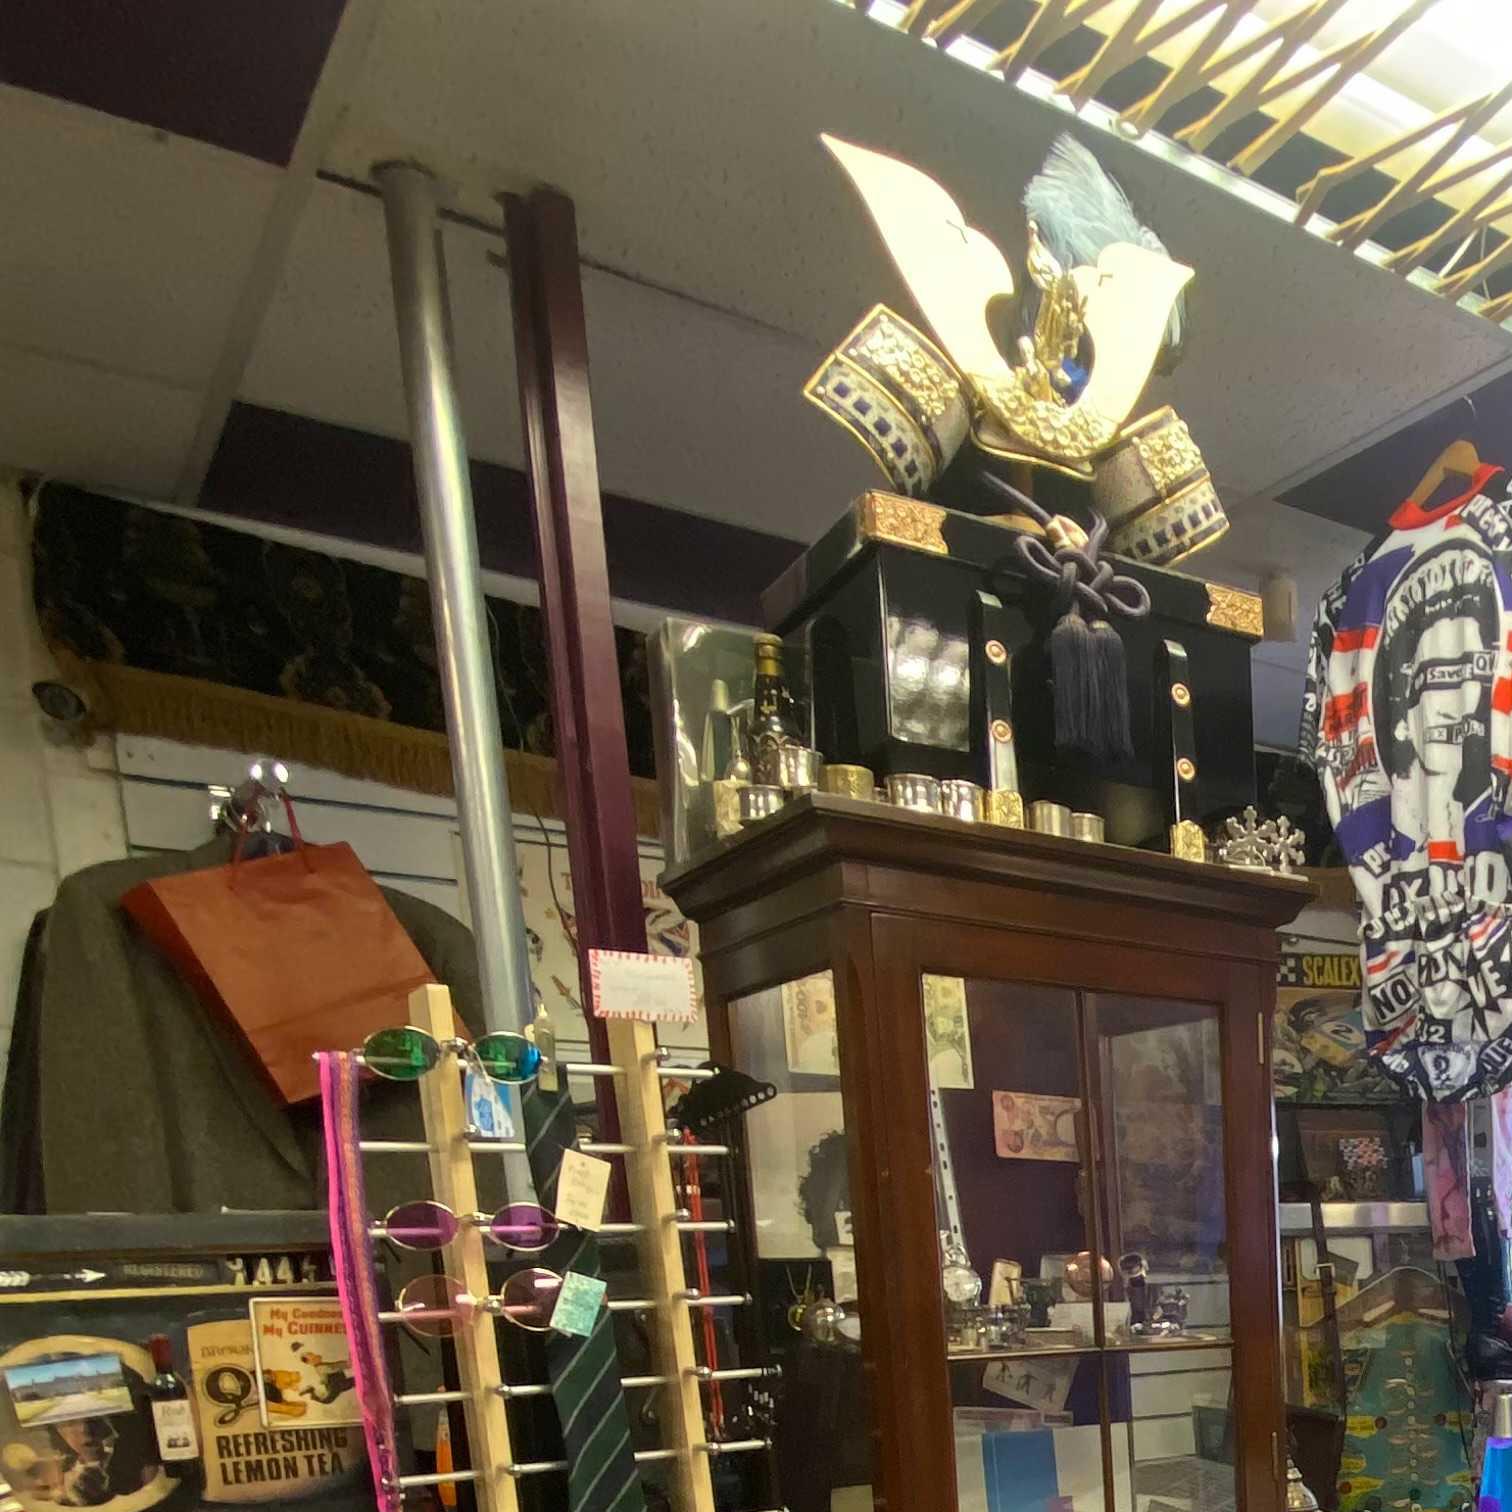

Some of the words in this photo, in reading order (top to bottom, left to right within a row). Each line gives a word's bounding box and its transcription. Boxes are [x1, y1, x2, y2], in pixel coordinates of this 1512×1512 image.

[1370, 977, 1412, 1020] NO
[215, 1427, 348, 1459] REFRESHING
[219, 1456, 299, 1485] LEMON
[303, 1452, 344, 1477] TEA
